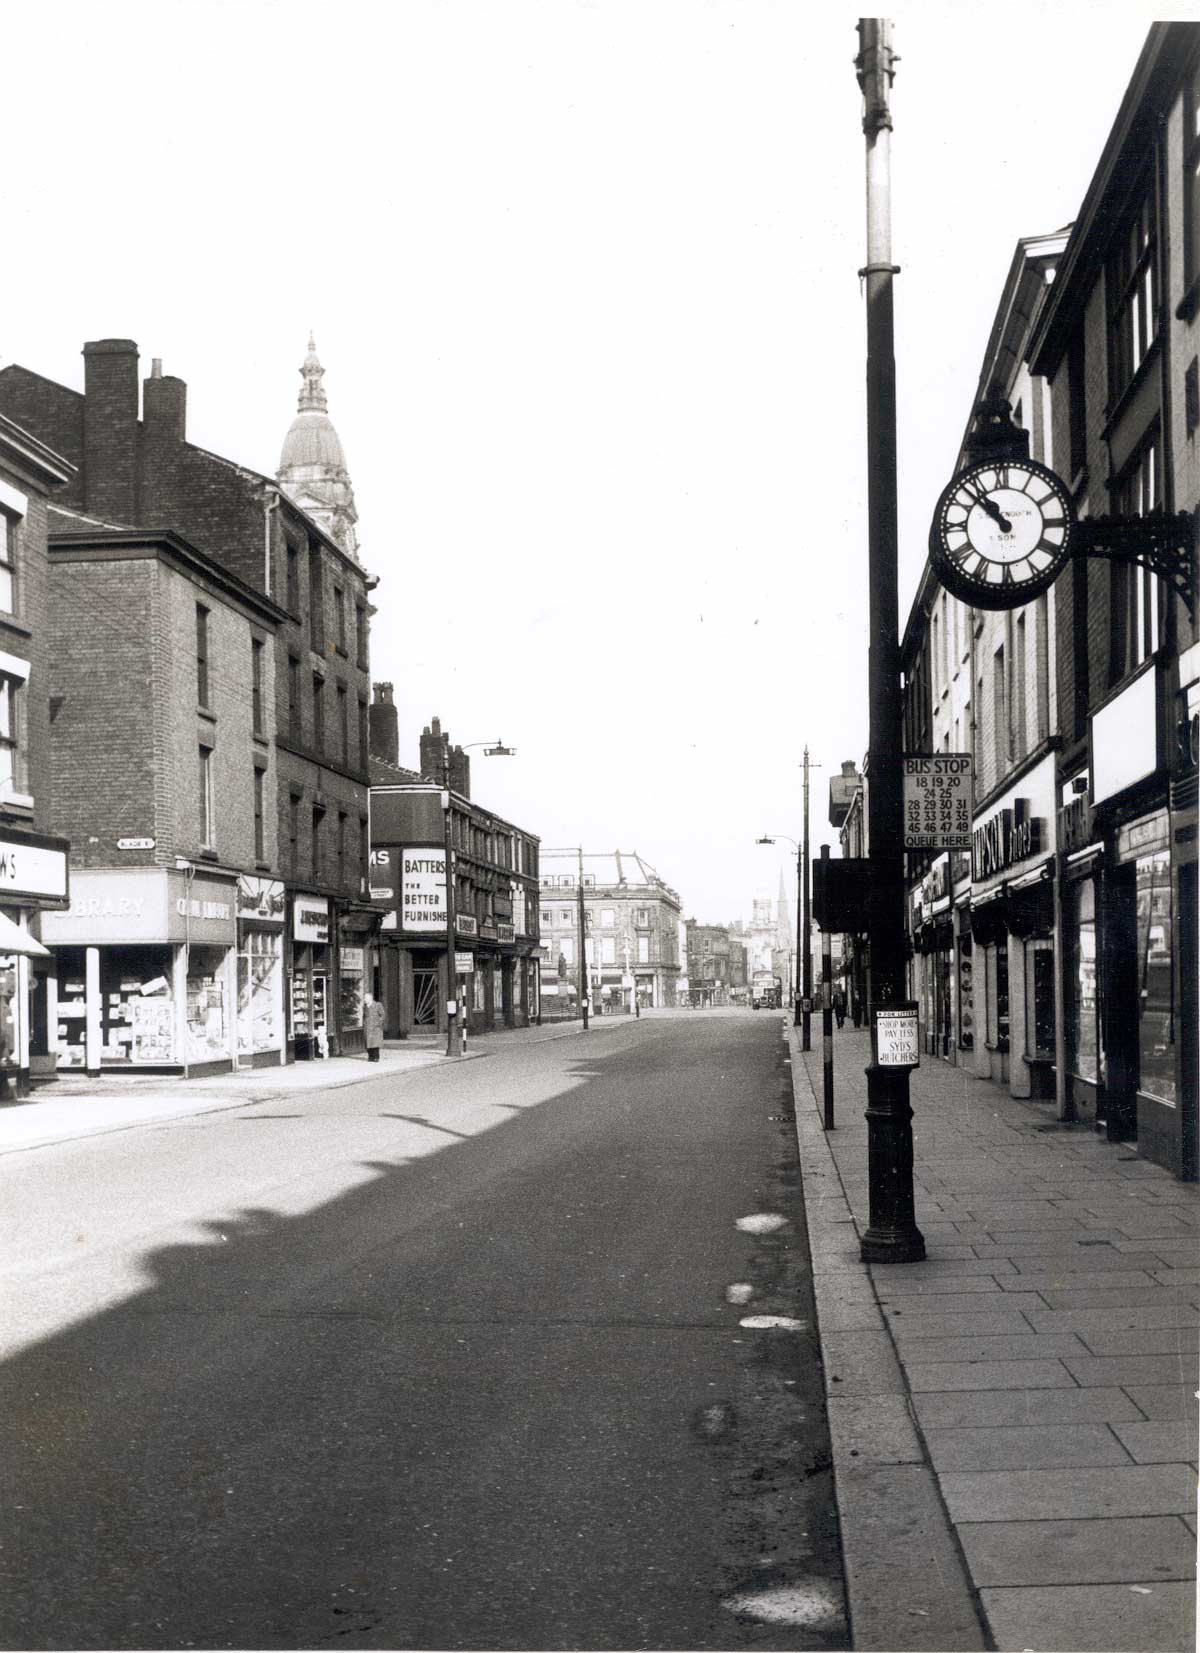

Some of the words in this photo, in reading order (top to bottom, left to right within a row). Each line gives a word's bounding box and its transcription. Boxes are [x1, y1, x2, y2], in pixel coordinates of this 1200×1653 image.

[906, 760, 931, 774] BUS
[934, 760, 970, 774] STOP
[916, 777, 928, 787] 18
[932, 777, 944, 787] 19
[947, 777, 961, 787] 20
[924, 788, 936, 799] 24
[939, 788, 952, 799] 25
[908, 800, 920, 810] 28
[924, 800, 937, 810] 29
[939, 800, 952, 809] 30
[956, 799, 967, 809] 31
[908, 811, 920, 821] 32
[924, 811, 937, 821] 33
[939, 811, 952, 820] 34
[956, 811, 968, 820] 35
[908, 822, 921, 833] 45
[924, 822, 937, 832] 46
[940, 822, 953, 832] 47
[956, 822, 968, 832] 49
[906, 836, 939, 847] QUEUE
[941, 836, 970, 846] HERE
[405, 894, 440, 905] BETTER
[405, 911, 448, 922] FURNISHE
[884, 1029, 897, 1038] PAY
[899, 1029, 914, 1038] LESS
[881, 1052, 918, 1063] BUTCHERS
